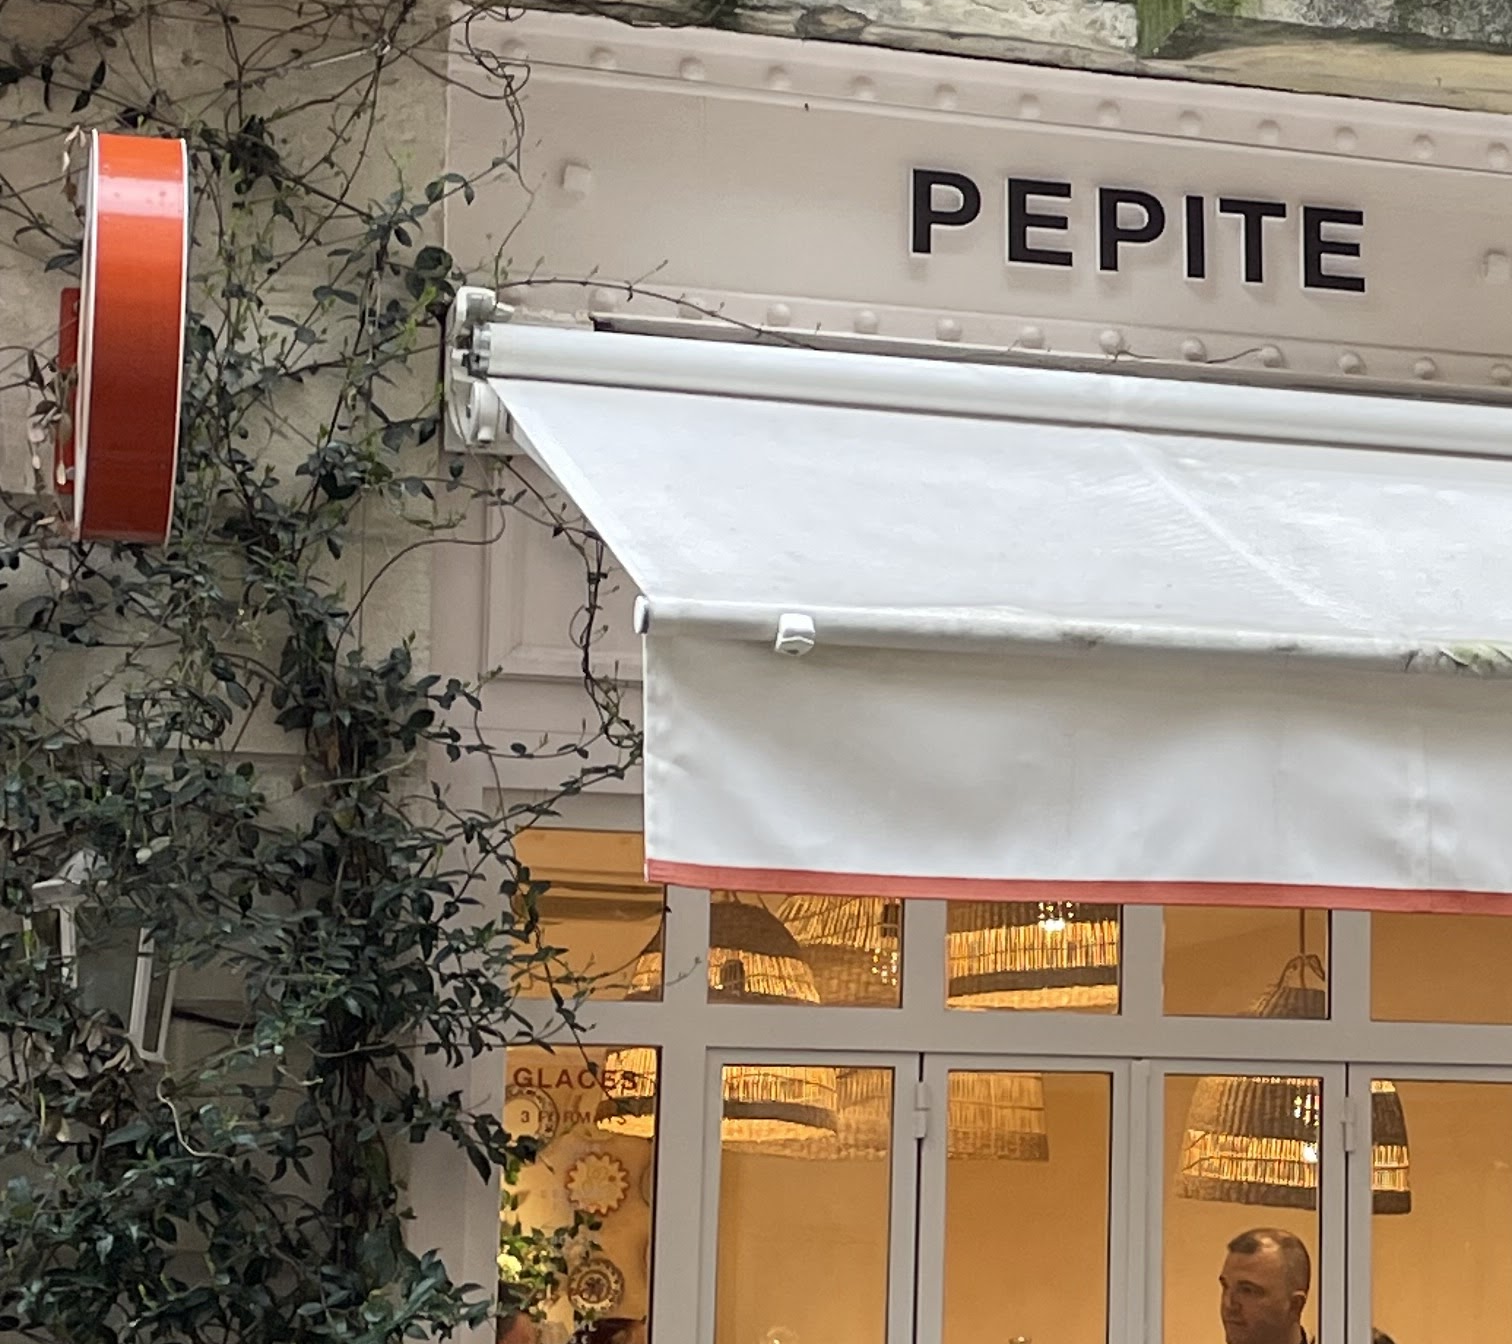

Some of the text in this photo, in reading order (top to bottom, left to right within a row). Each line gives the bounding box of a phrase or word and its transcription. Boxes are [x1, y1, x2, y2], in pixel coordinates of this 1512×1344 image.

[911, 168, 1367, 293] PEPITE
[513, 1066, 638, 1090] GLACES
[521, 1110, 530, 1123] 3
